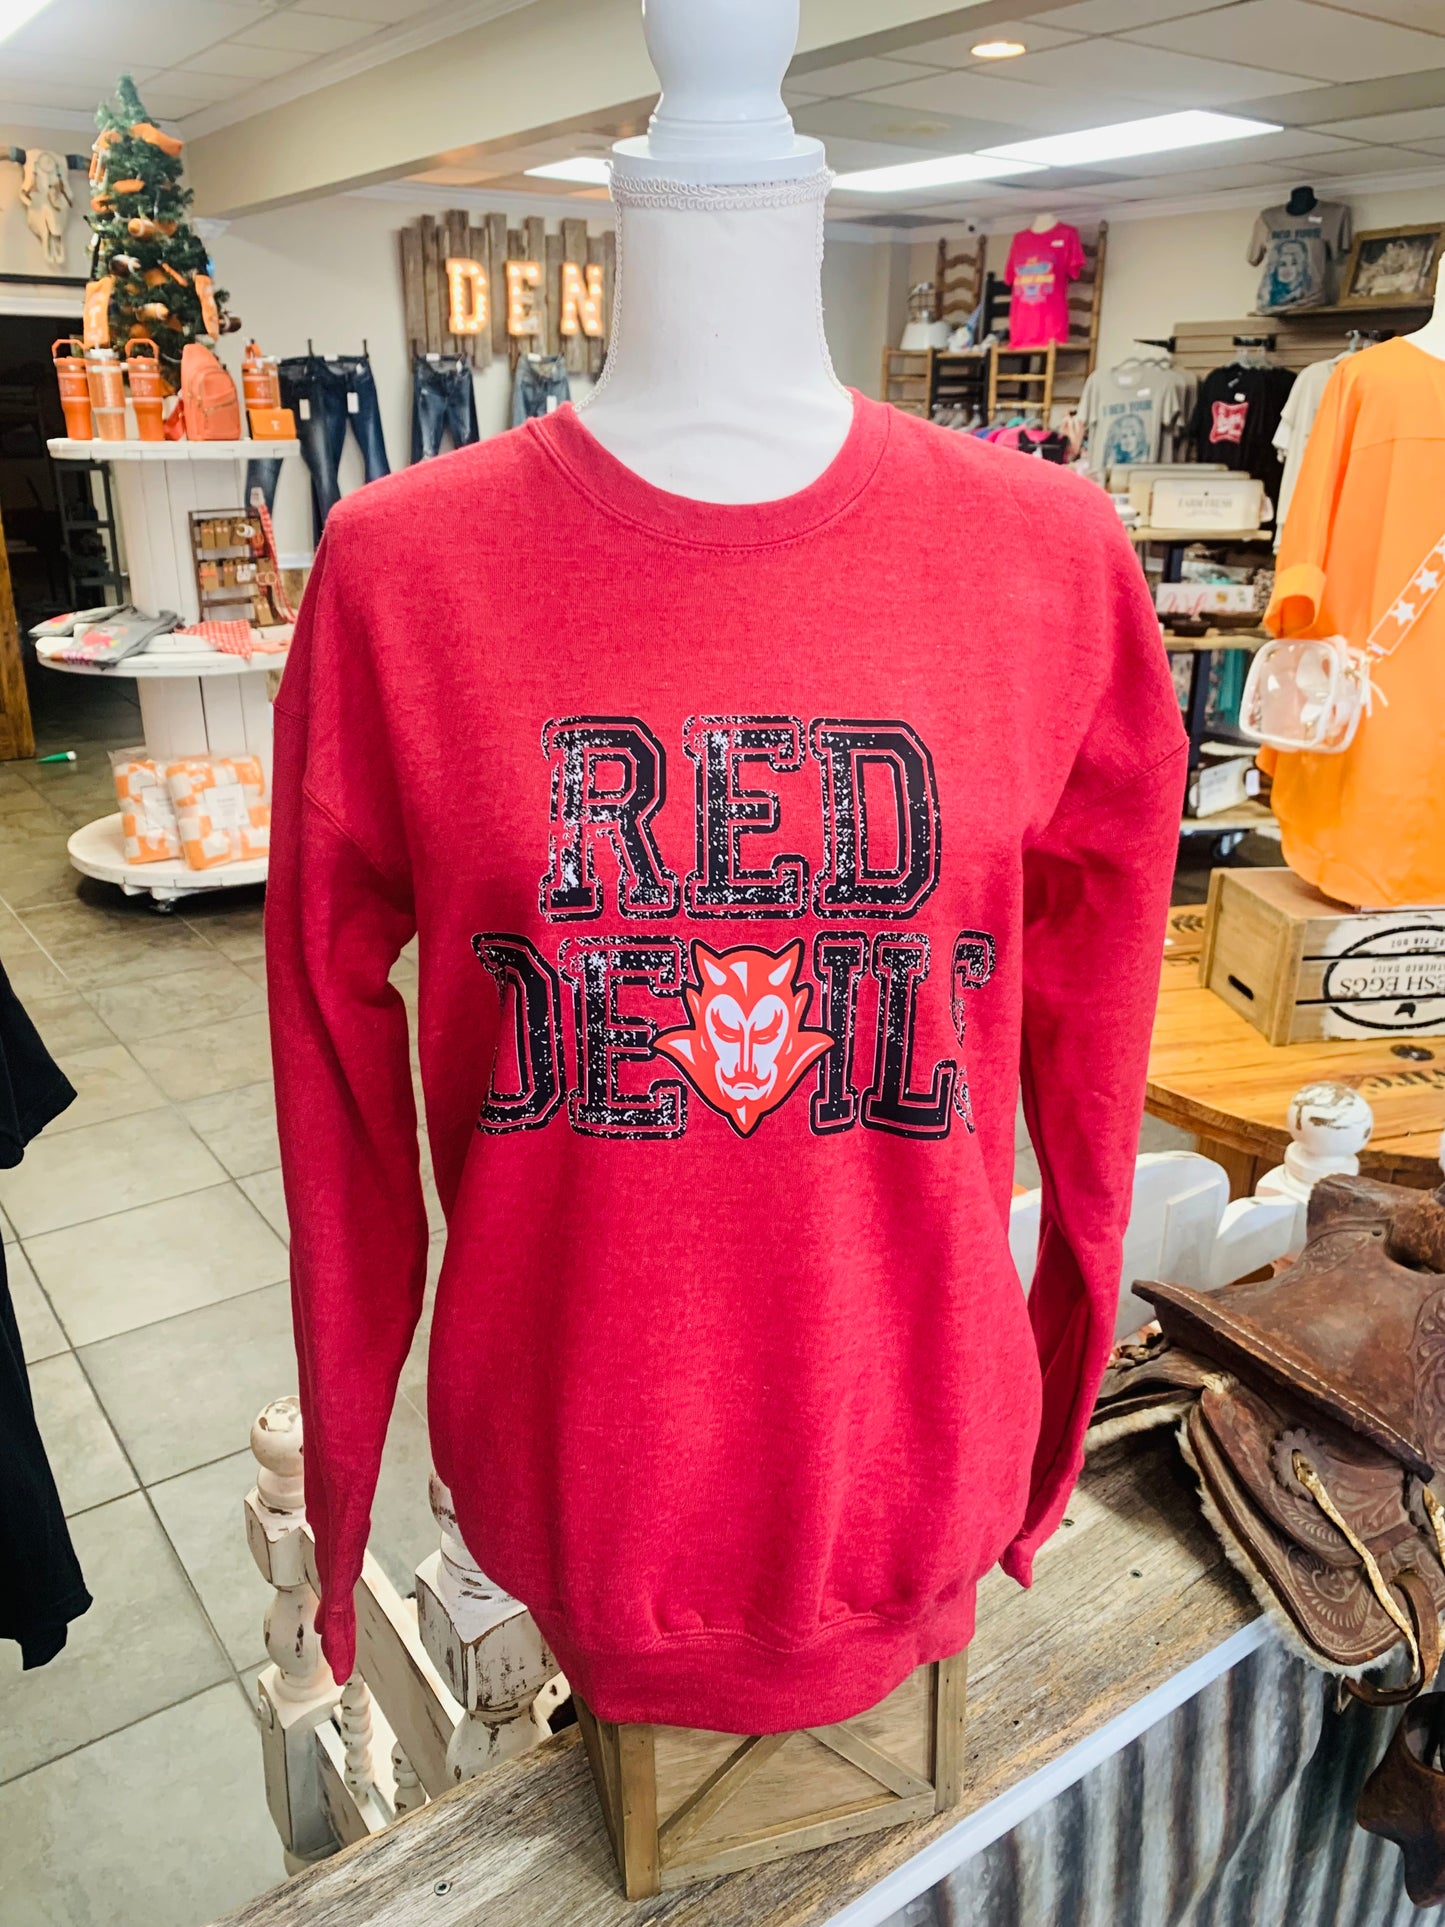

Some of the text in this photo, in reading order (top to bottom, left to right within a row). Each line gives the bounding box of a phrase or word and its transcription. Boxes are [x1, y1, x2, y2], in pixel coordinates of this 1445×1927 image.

[446, 258, 603, 336] DEN
[538, 714, 943, 923] RED
[1340, 976, 1399, 994] EGGS
[1370, 964, 1400, 975] DAILY
